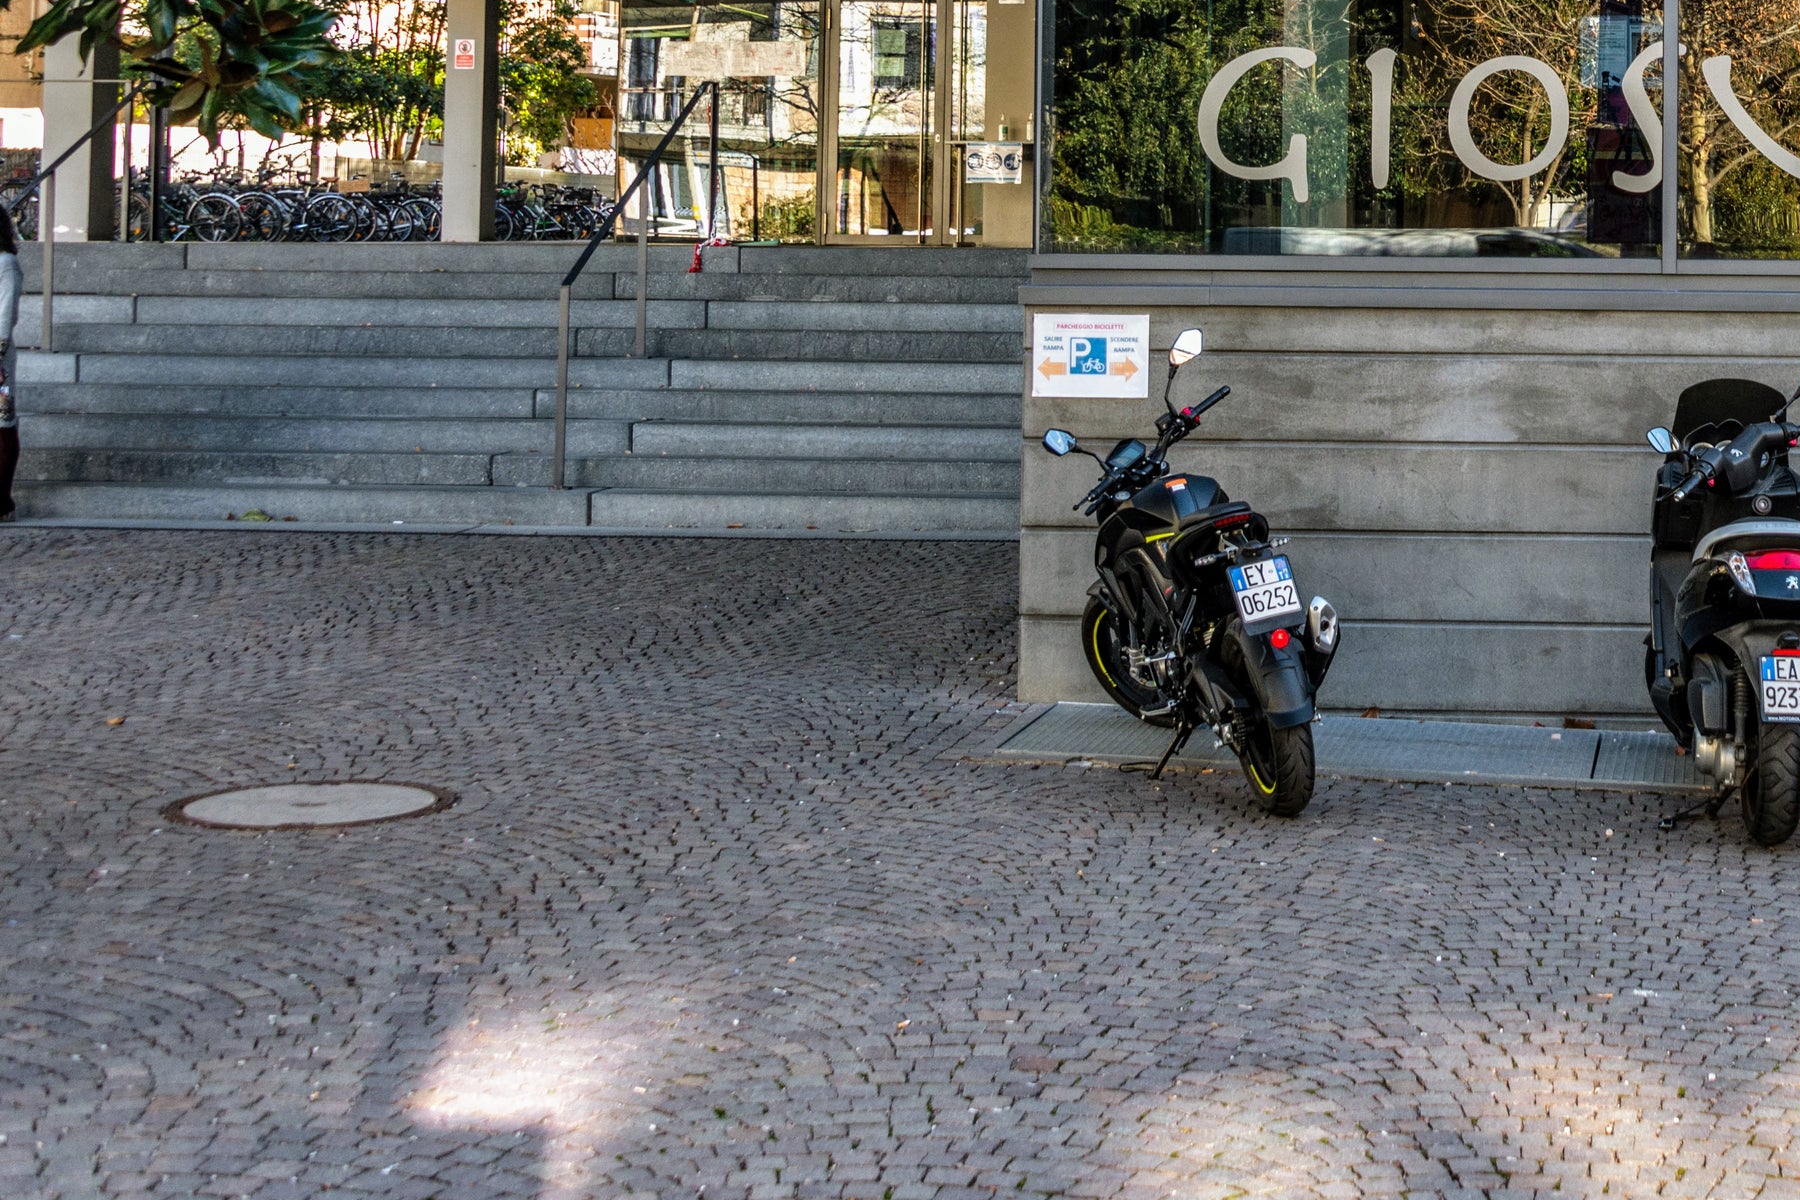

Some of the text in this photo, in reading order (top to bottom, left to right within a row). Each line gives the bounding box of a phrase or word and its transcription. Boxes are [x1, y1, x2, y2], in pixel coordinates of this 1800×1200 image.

[1243, 563, 1266, 587] EY
[1241, 585, 1297, 616] 06252
[1776, 659, 1798, 680] EA
